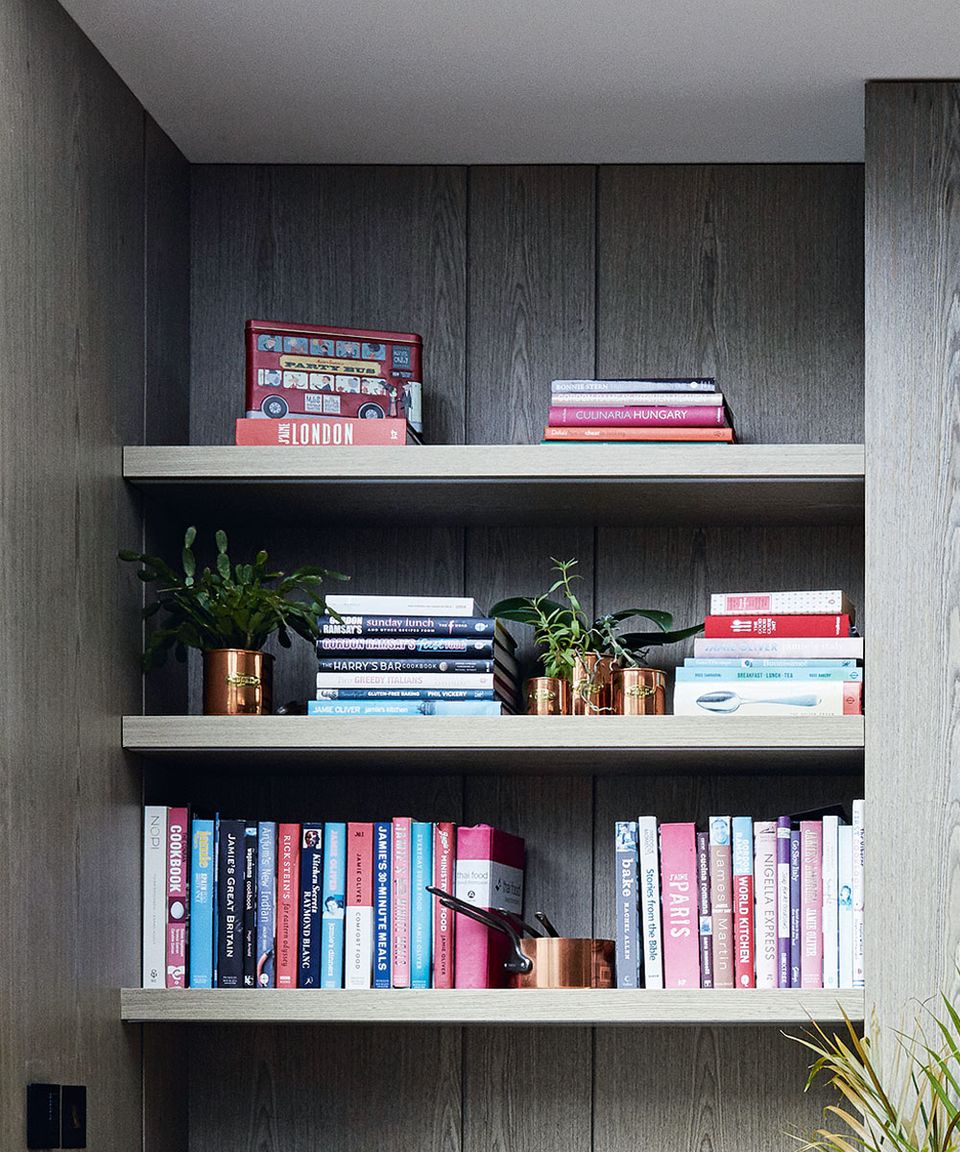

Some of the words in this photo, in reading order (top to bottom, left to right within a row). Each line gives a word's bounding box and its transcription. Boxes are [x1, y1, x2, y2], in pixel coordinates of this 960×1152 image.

[284, 361, 341, 372] PARTY
[343, 366, 376, 375] BUS
[575, 411, 631, 420] CULINARIA
[633, 410, 688, 420] HUNGARY
[292, 423, 354, 445] LONDON
[323, 624, 363, 635] RAMSAY'S
[366, 618, 402, 629] sunday
[405, 617, 434, 627] lunch
[333, 661, 378, 671] HARRY'S
[380, 661, 402, 671] BAR
[354, 675, 385, 685] GREEDY
[387, 675, 423, 685] ITALIANS
[313, 705, 334, 713] JAMIE
[334, 705, 361, 714] OLIVER
[151, 815, 160, 850] NOPI
[260, 828, 272, 865] Anjum's
[283, 834, 292, 859] RICK
[378, 825, 388, 871] JAMIE'S
[169, 824, 183, 893] COOKBOOK
[226, 833, 237, 874] JAMIE'S
[311, 853, 320, 884] Kitchen
[700, 853, 708, 881] cucina
[260, 867, 272, 888] New
[283, 861, 292, 899] STEIN'S
[621, 858, 634, 898] bake
[645, 868, 656, 898] Stories
[716, 850, 726, 904] James
[763, 853, 775, 905] NIGELLA
[226, 877, 237, 912] GREAT
[260, 889, 272, 923] Indian
[311, 884, 320, 913] Secrets
[378, 872, 387, 930] 30-MINUTE
[646, 900, 656, 921] from
[669, 880, 691, 938] PARIS
[701, 882, 709, 915] romana
[739, 877, 749, 915] WORLD
[302, 890, 311, 937] RAYMOND
[225, 915, 236, 958] BRITAIN
[648, 923, 657, 939] the
[718, 918, 729, 970] Martin
[739, 917, 750, 964] KITCHEN
[764, 910, 775, 961] EXPRESS
[302, 938, 311, 969] BLANC
[377, 931, 387, 971] MEALS
[648, 940, 658, 961] Bible
